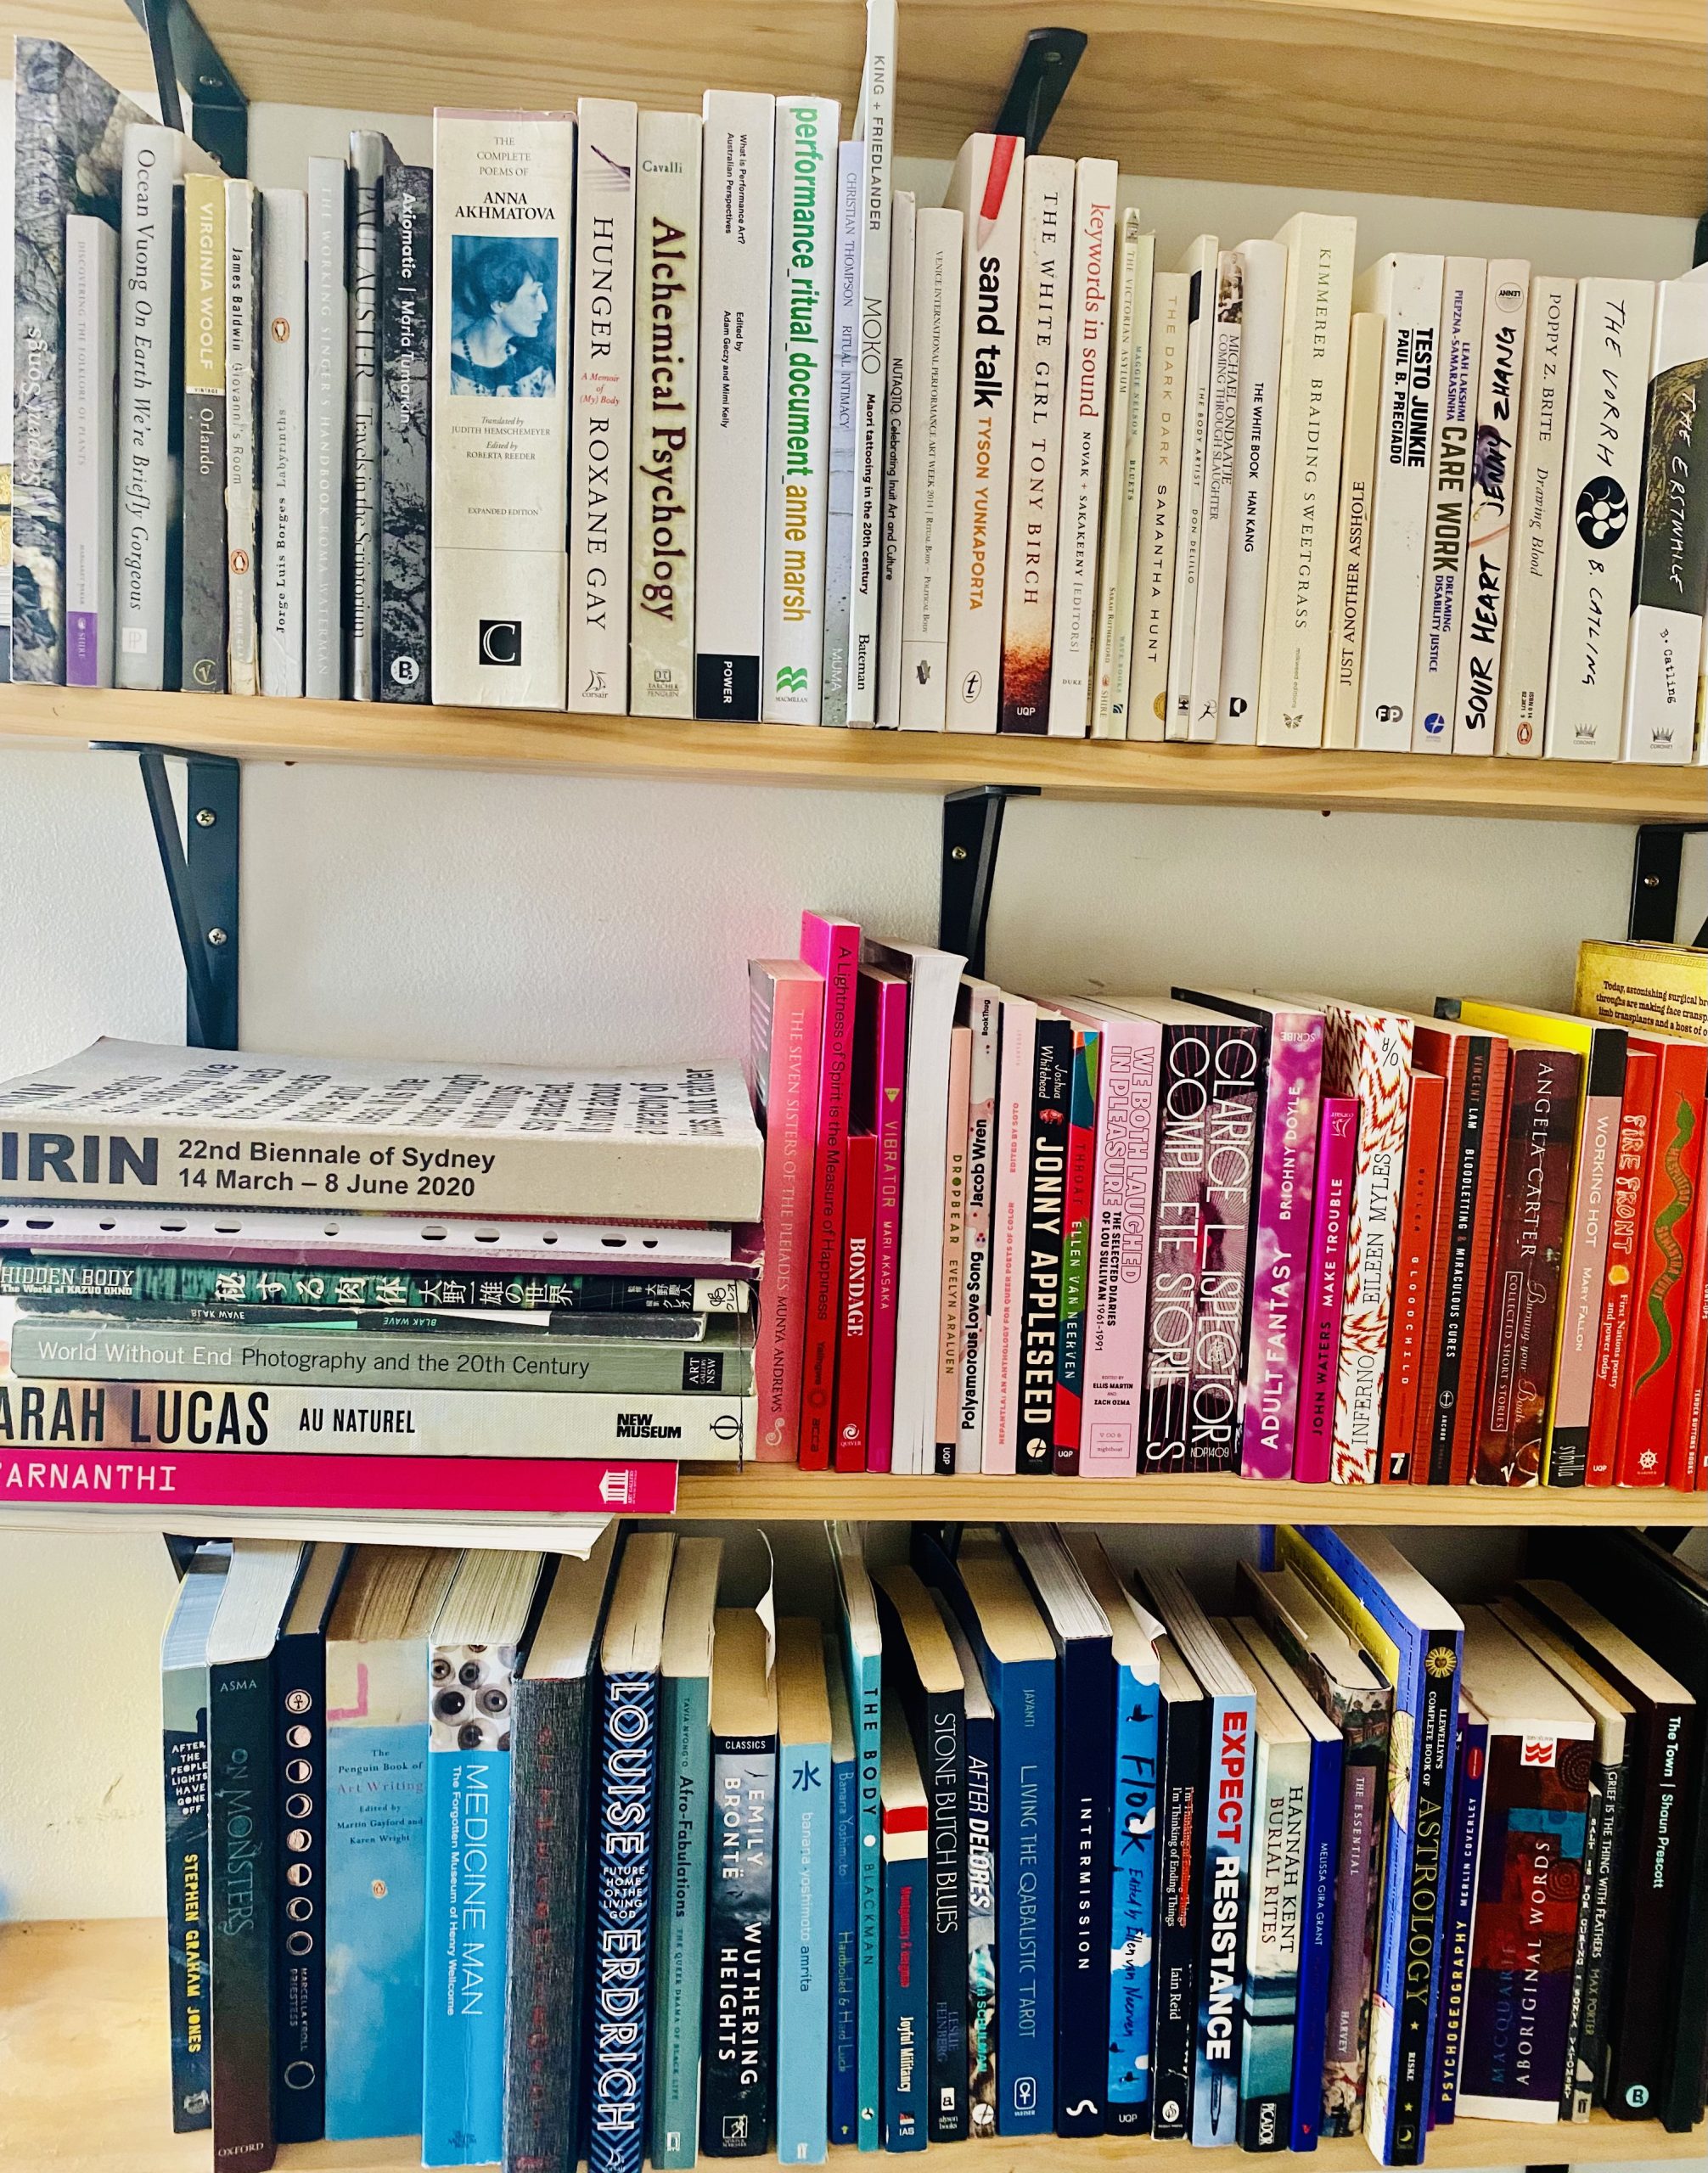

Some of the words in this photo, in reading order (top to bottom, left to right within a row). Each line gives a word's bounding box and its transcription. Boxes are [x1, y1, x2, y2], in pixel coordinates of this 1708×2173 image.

[136, 149, 155, 217] Ocean
[643, 160, 683, 174] Cavalli
[726, 133, 734, 177] Australian
[869, 116, 884, 231] FRIEDLANDER
[455, 206, 556, 220] AKHMATOVA
[484, 192, 528, 205] ANNA
[725, 180, 733, 233] Perspectives
[738, 170, 747, 223] Performance
[1042, 192, 1059, 244] THE
[128, 224, 155, 291] Vuong
[200, 202, 214, 291] VIRGINIA
[401, 193, 416, 278] Axiomatic
[738, 226, 746, 244] Art?
[1084, 203, 1110, 312] keywords
[232, 248, 243, 292] James
[591, 217, 614, 359] HUNGER
[978, 256, 1005, 334] sand
[134, 300, 153, 330] On
[200, 298, 214, 369] WOOLF
[232, 296, 243, 351] Baldwin
[401, 300, 414, 346] Maria
[652, 217, 686, 412] Alchemical
[1037, 260, 1055, 345] WHITE
[1545, 294, 1561, 357] POPPY
[132, 334, 153, 390] Earth
[862, 296, 882, 374] MOKO
[1413, 328, 1435, 390] TESTO
[399, 352, 414, 424] Tumarkin
[974, 345, 1003, 409] talk
[1033, 362, 1050, 424] GIRL
[1079, 347, 1098, 417] sound
[1253, 383, 1264, 402] THE
[132, 398, 151, 446] We're
[200, 408, 214, 474] Orlando
[1251, 407, 1262, 441] WHITE
[1390, 390, 1406, 464] PRECIADO
[1407, 396, 1429, 468] JUNKIE
[1539, 388, 1554, 441] BRITE
[976, 417, 992, 479] TYSON
[1029, 439, 1046, 510] TONY
[1249, 445, 1260, 479] BOOK
[1438, 426, 1467, 492] CARE
[126, 455, 150, 519] Briefly
[587, 417, 609, 554] ROXANE
[1247, 491, 1258, 516] HAN
[639, 427, 686, 622] Psychology
[969, 487, 989, 610] YUNKAPORTA
[1151, 486, 1166, 598] SAMANTHA
[1244, 519, 1256, 553] KANG
[1433, 503, 1463, 571] WORK
[125, 526, 149, 610] Gorgeous
[1024, 524, 1042, 604] BIRCH
[587, 568, 607, 631] GAY
[857, 634, 869, 691] Bateman
[1147, 609, 1161, 663] HUNT
[723, 661, 733, 703] POWER
[1668, 992, 1697, 1005] surgical
[973, 1119, 987, 1161] Wren
[1127, 1092, 1150, 1159] BOTH
[1205, 1039, 1257, 1204] CLARICE
[1467, 1108, 1479, 1129] LAM
[1530, 1063, 1553, 1157] ANGELA
[178, 1139, 240, 1161] 22nd
[250, 1141, 360, 1165] Biennale
[402, 1147, 496, 1172] Sydney
[1102, 1079, 1126, 1206] PLEASURE
[1589, 1116, 1610, 1204] WORKING
[179, 1168, 206, 1188] 14
[216, 1169, 293, 1191] March
[347, 1175, 408, 1195] June
[417, 1176, 475, 1197] 2020
[1032, 1137, 1064, 1235] JONNY
[1458, 1148, 1475, 1230] BLOODLETTING
[1521, 1168, 1544, 1259] CARTER
[1070, 1221, 1082, 1267] ELLEN
[1121, 1165, 1146, 1283] LAUGHED
[1326, 1179, 1342, 1253] TROUBLE
[1585, 1210, 1599, 1248] HOT
[846, 1238, 866, 1337] BONDAGE
[947, 1261, 958, 1308] EVELYN
[968, 1252, 984, 1290] Song
[1323, 1261, 1337, 1306] MAKE
[1449, 1249, 1465, 1317] MIRACULOUS
[966, 1294, 980, 1329] Love
[1267, 1250, 1291, 1358] FANTASY
[1617, 1294, 1628, 1317] First
[39, 1340, 96, 1362] World
[105, 1343, 184, 1365] Without
[194, 1346, 232, 1366] End
[243, 1348, 366, 1373] Photography
[457, 1354, 505, 1374] 20th
[513, 1356, 589, 1379] Century
[946, 1314, 957, 1374] ARALUEN
[1024, 1251, 1058, 1423] APPLESEED
[1065, 1312, 1077, 1379] NEERVEN
[1447, 1323, 1458, 1357] CURES
[1615, 1320, 1626, 1357] Nations
[962, 1333, 978, 1429] Polyamorous
[1609, 1360, 1621, 1389] poetry
[132, 1389, 269, 1445] LUCAS
[300, 1408, 323, 1431] AU
[334, 1408, 415, 1434] NATUREL
[616, 1425, 682, 1438] MUSEUM
[617, 1413, 653, 1427] NEW
[1261, 1369, 1284, 1450] ADULT
[220, 1679, 257, 1692] ASMA
[864, 1688, 878, 1732] THE
[605, 1682, 649, 1855] LOUISE
[725, 1740, 766, 1749] CLASSICS
[935, 1713, 957, 1785] STONE
[862, 1750, 876, 1816] BODY
[968, 1755, 988, 1813] AFTER
[1217, 1710, 1247, 1844] EXPECT
[451, 1791, 461, 1848] Forgotten
[722, 1777, 744, 1878] BRONTË
[746, 1789, 765, 1868] EMILY
[935, 1793, 957, 1865] BUTCH
[1168, 1804, 1181, 1847] Thinking
[1266, 1797, 1284, 1878] BURIAL
[1283, 1786, 1303, 1889] HANNAH
[1658, 1794, 1673, 1833] Shaun
[450, 1851, 460, 1903] Museum
[463, 1764, 489, 1930] MEDICINE
[675, 1776, 694, 1918] Afro-Fabulations
[969, 1817, 990, 1909] DELORES
[1166, 1861, 1179, 1894] Ending
[1653, 1837, 1669, 1889] Prescott
[184, 1854, 199, 1922] STEPHEN
[936, 1873, 958, 1934] BLUES
[1077, 1798, 1093, 1970] INTERMISSION
[1166, 1896, 1177, 1927] Things
[1261, 1885, 1279, 1944] RITES
[1406, 1796, 1442, 2005] ASTROLOGY
[1280, 1895, 1297, 1953] KENT
[1592, 1908, 1605, 1958] FEATHERS
[186, 1930, 200, 1997] GRAHAM
[461, 1943, 484, 2015] MAN
[800, 1946, 812, 1992] amrita
[1205, 1856, 1240, 2060] RESISTANCE
[1515, 1940, 1542, 2085] ABORIGINAL
[1529, 1843, 1550, 1925] WORDS
[188, 2007, 201, 2052] JONES
[597, 1929, 642, 2131] ERDRICH
[719, 1948, 738, 2061] HEIGHTS
[741, 1922, 761, 2086] WUTHERING
[1019, 1979, 1036, 2038] TAROT
[1170, 1992, 1181, 2020] Reid
